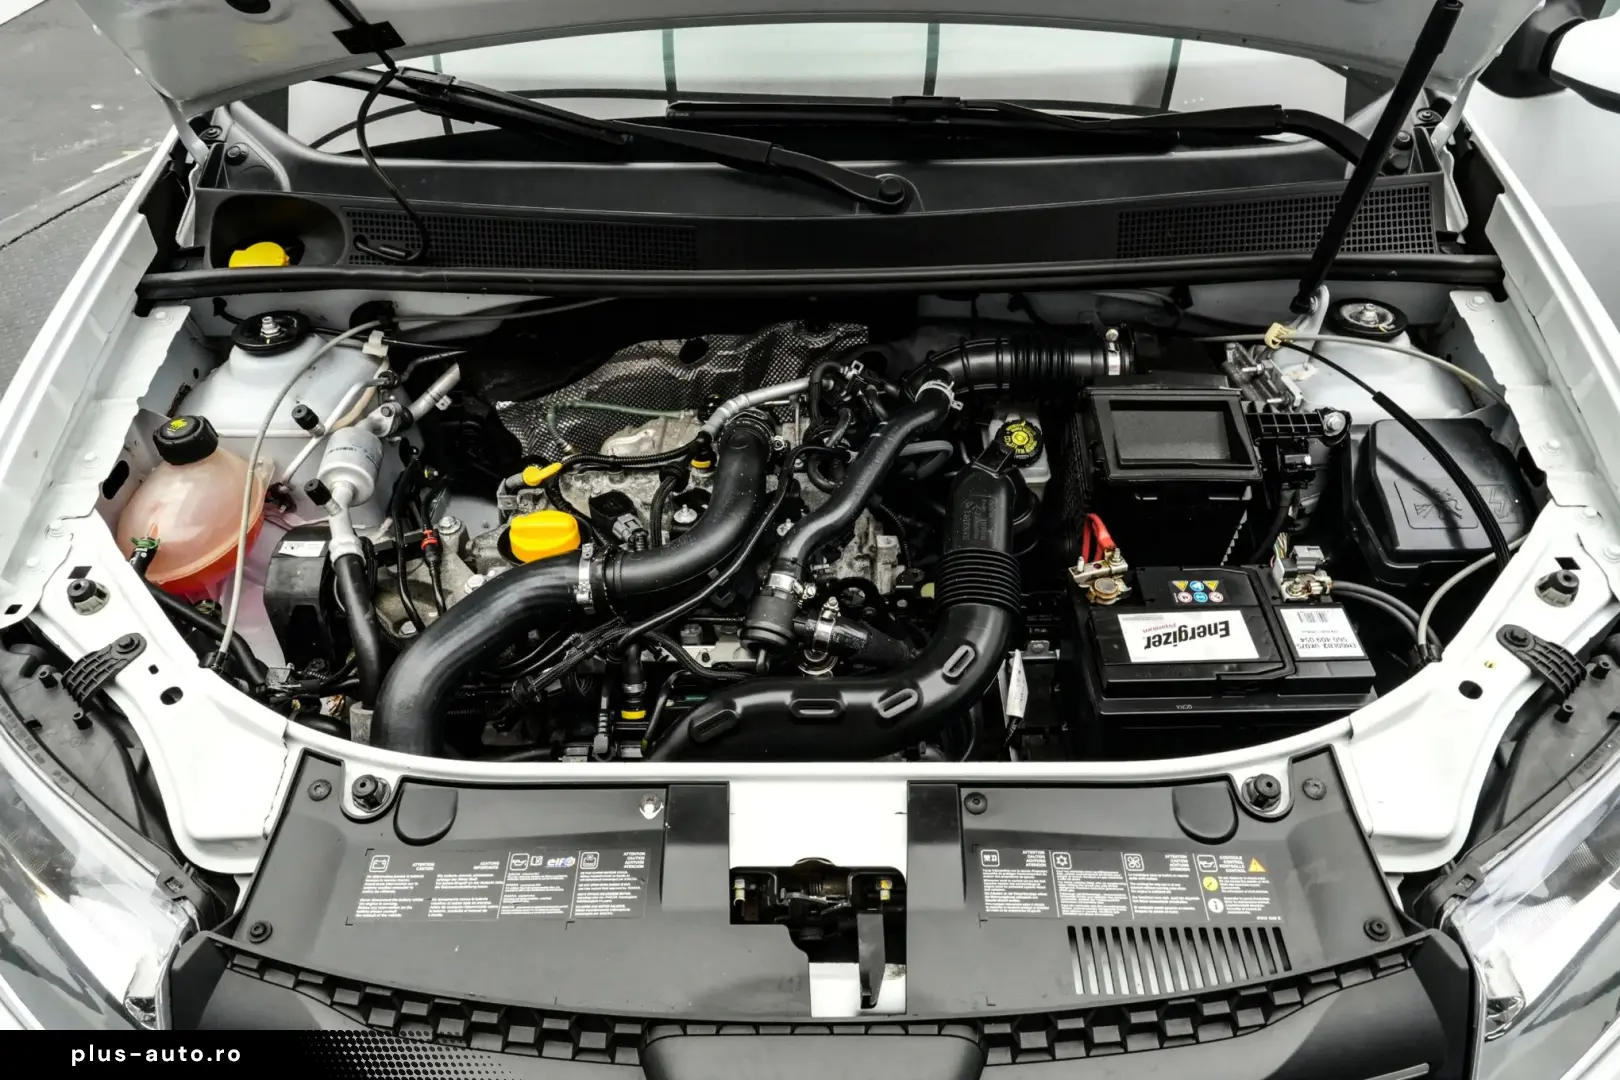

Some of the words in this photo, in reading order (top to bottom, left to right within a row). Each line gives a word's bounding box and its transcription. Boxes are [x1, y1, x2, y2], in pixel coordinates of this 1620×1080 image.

[1142, 622, 1177, 634] Premium
[1143, 620, 1231, 650] Energizer
[547, 857, 565, 866] elf
